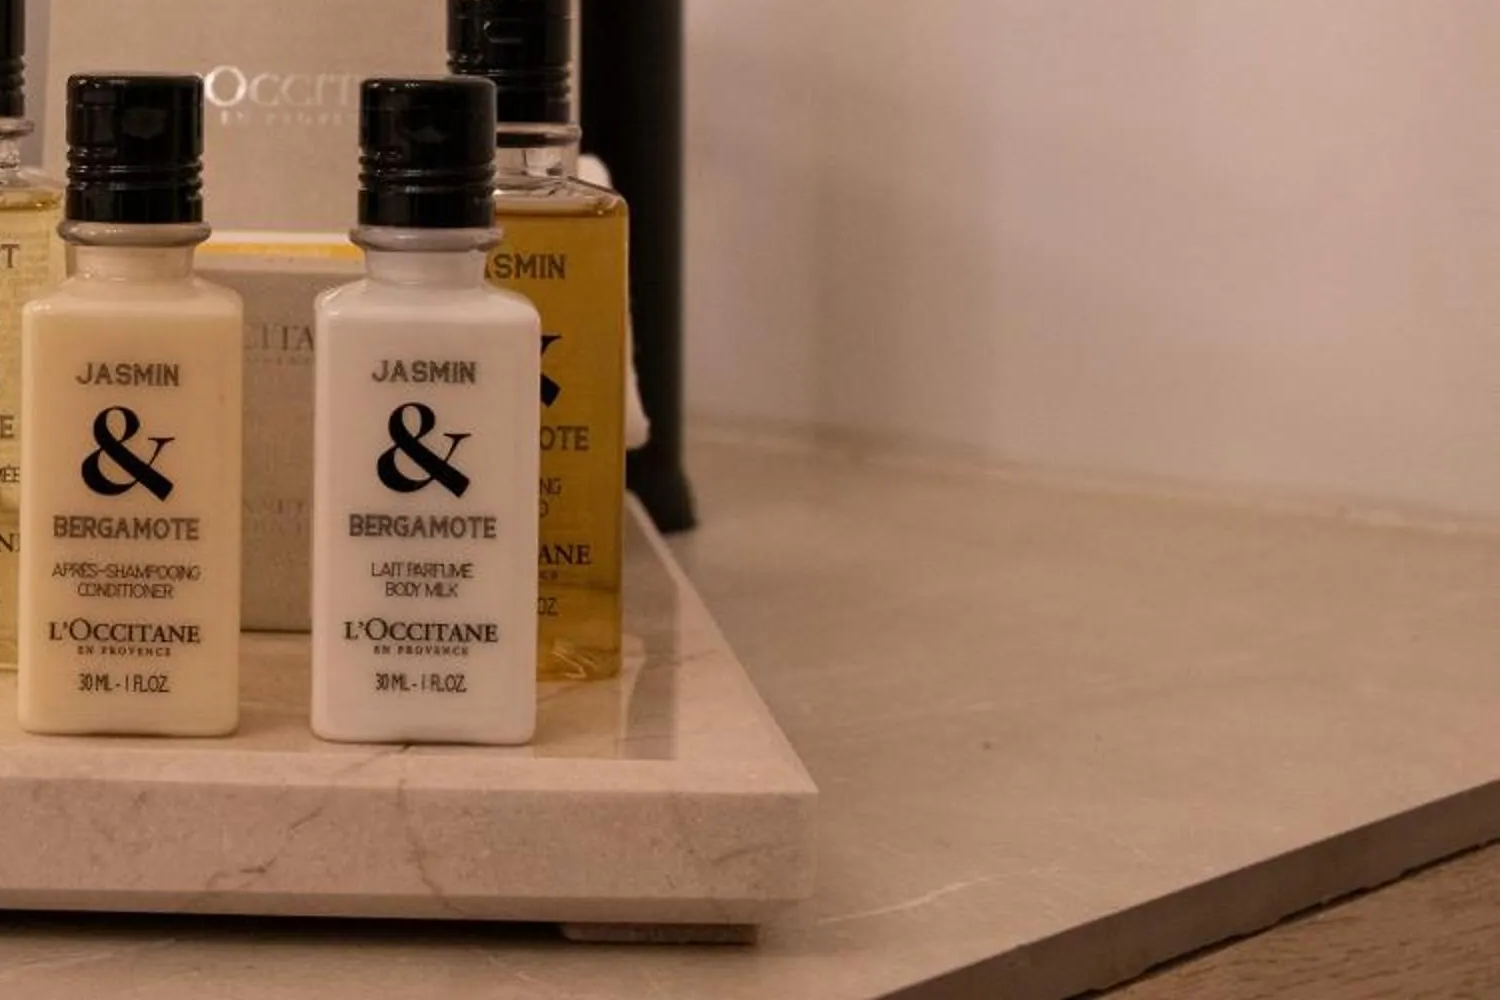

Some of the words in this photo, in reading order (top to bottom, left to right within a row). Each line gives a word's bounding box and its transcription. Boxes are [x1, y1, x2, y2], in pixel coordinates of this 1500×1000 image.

[204, 65, 360, 106] OCCIT
[484, 253, 566, 280] SMIN
[75, 362, 180, 387] JASMIN
[371, 359, 477, 384] JASMIN
[81, 405, 176, 502] &
[377, 401, 472, 498] &
[53, 514, 200, 541] BERGAMOTE
[349, 513, 497, 539] BERGAMOTE
[371, 561, 403, 577] LAIT
[77, 582, 174, 599] CONDITIONER
[385, 581, 421, 598] BODY
[426, 582, 459, 598] MILK
[48, 617, 201, 644] L'OCCITANE
[343, 617, 499, 643] L'OCCITANE
[100, 645, 171, 657] PROVENCE
[397, 645, 469, 656] PROVENCE
[78, 673, 92, 691] 30
[95, 674, 113, 691] ML
[376, 672, 390, 691] 30
[392, 673, 410, 691] ML
